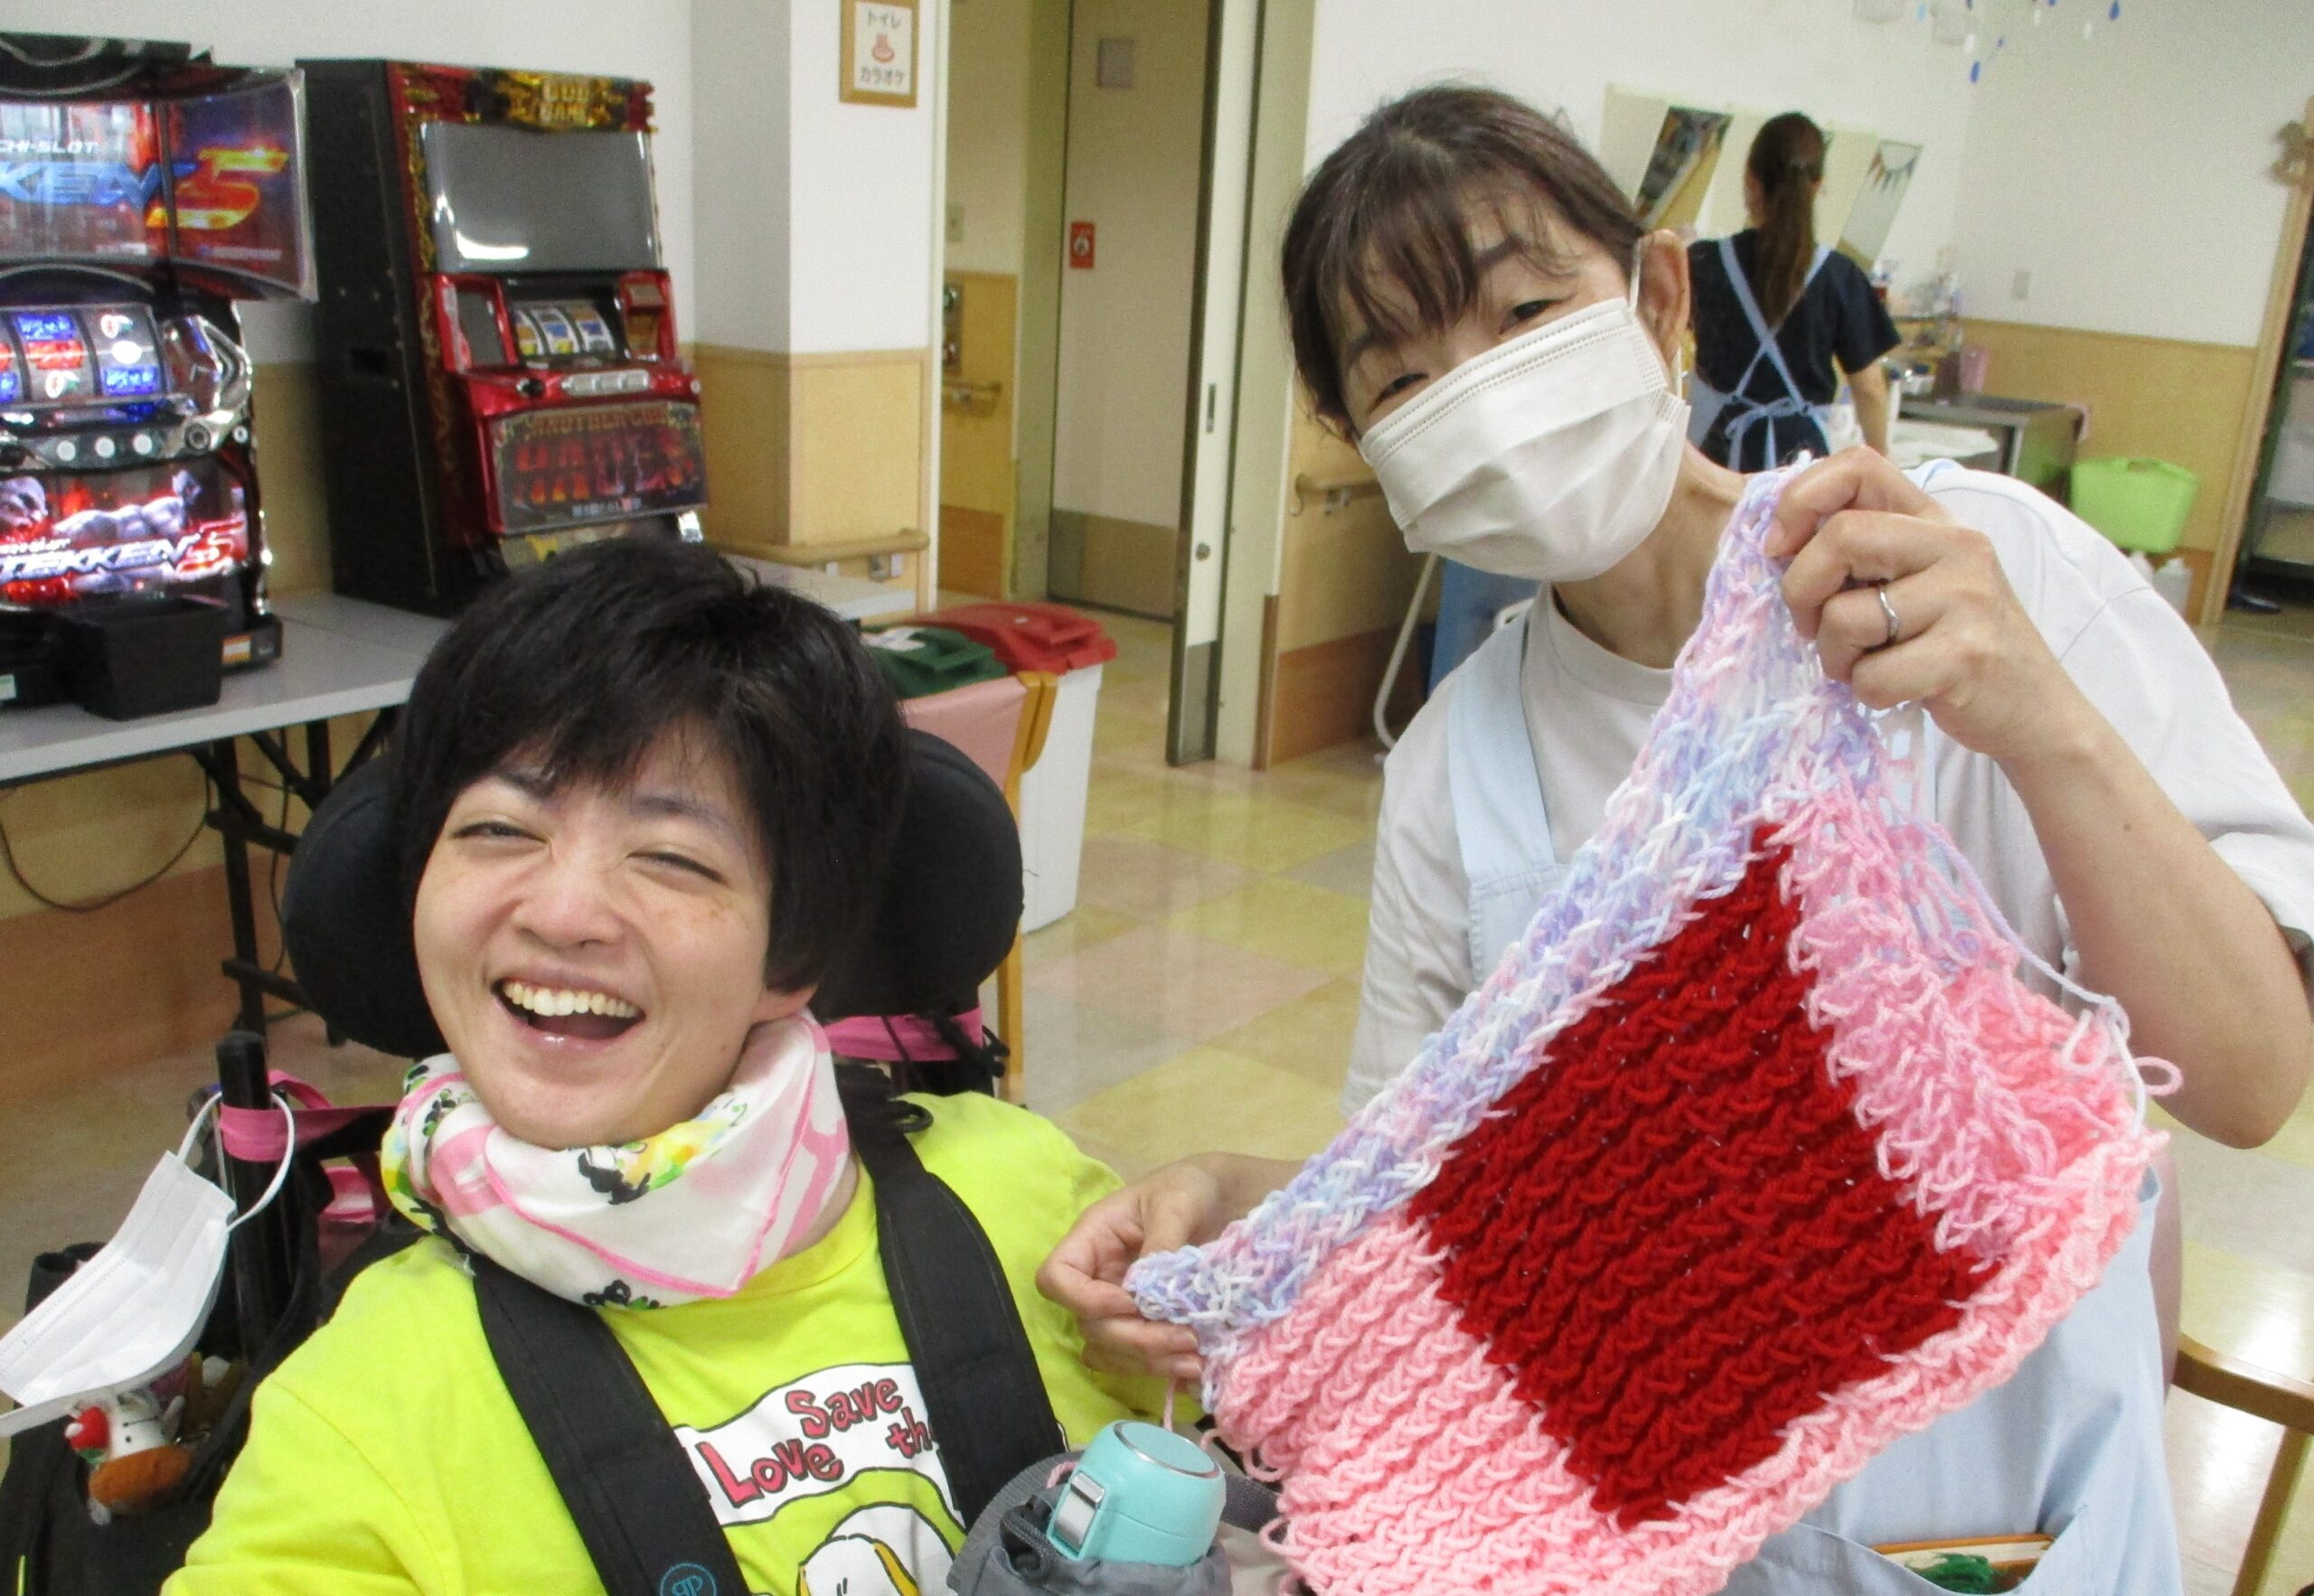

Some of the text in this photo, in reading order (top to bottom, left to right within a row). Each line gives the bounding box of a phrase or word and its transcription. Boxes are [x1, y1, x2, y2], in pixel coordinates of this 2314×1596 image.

[867, 8, 901, 30] トイレ
[859, 66, 905, 86] カラオケ
[146, 146, 289, 231] 5
[174, 520, 247, 581] 5
[785, 1377, 903, 1439] Save
[885, 1405, 936, 1460] th
[695, 1438, 845, 1508] Love
